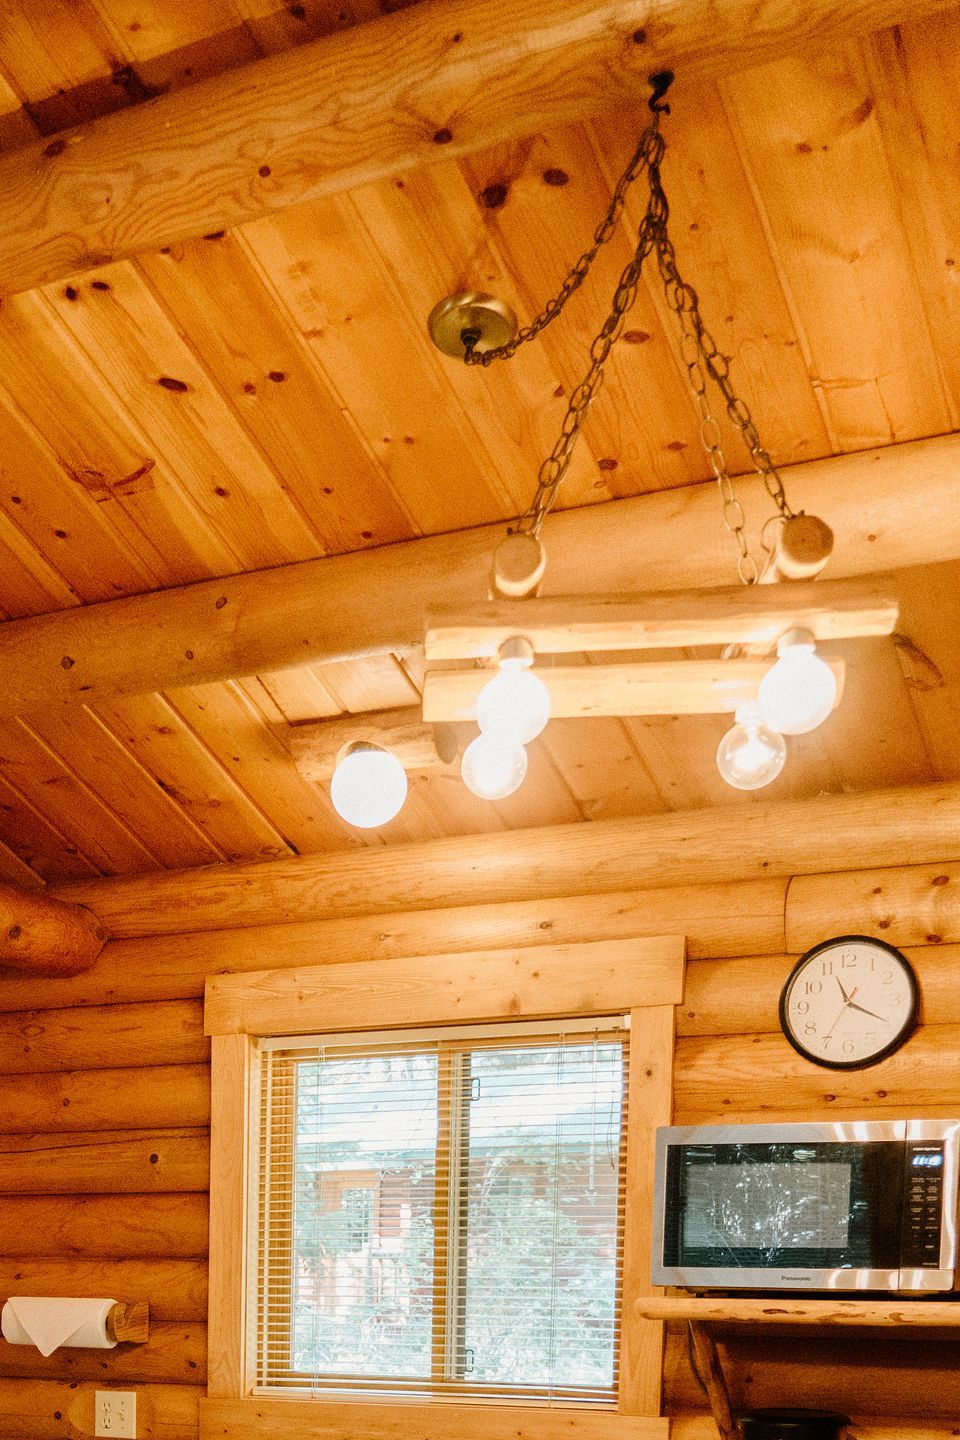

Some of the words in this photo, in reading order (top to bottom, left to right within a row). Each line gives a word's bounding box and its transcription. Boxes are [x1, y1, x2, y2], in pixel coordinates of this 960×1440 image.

[841, 953, 857, 968] 12
[870, 958, 876, 972] 1
[822, 962, 833, 976] 11
[804, 981, 823, 995] 10
[797, 1001, 810, 1015] 9
[804, 1022, 817, 1036] 8
[822, 1036, 833, 1050] 7
[842, 1039, 855, 1054] 6
